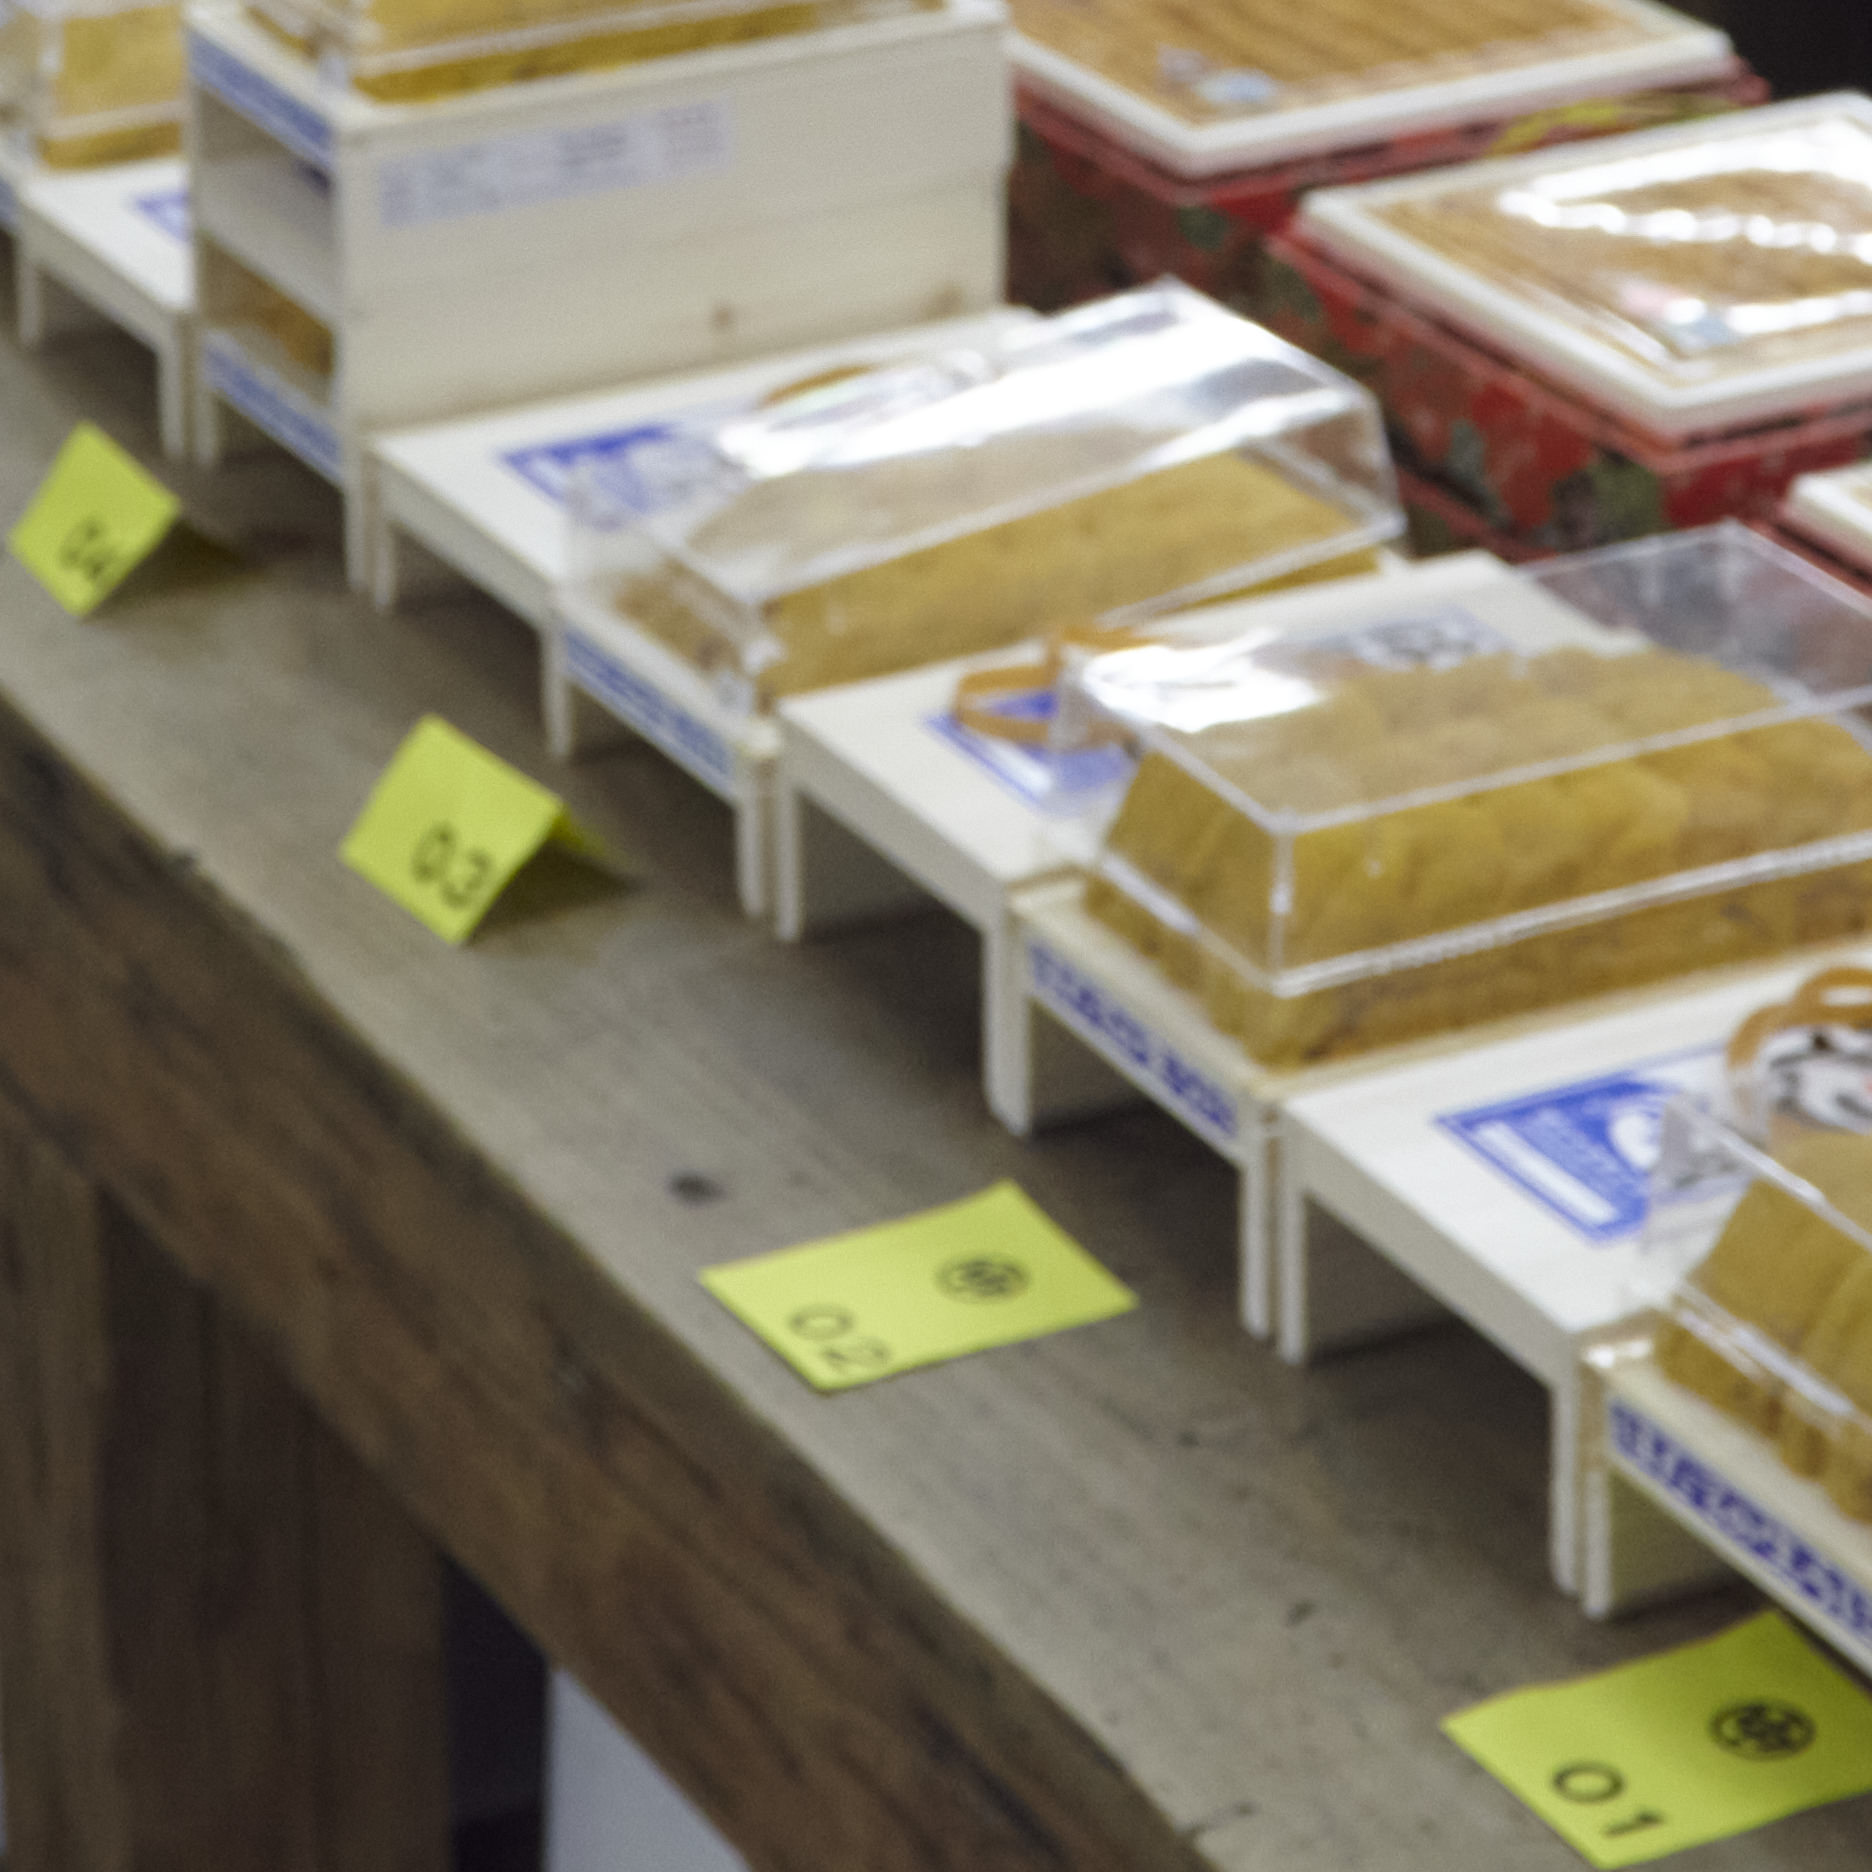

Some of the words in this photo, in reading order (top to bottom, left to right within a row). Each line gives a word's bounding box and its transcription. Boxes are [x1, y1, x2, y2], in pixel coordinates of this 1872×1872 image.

[409, 820, 496, 910] 03
[784, 1302, 895, 1373] 02
[1550, 1758, 1669, 1839] 01
